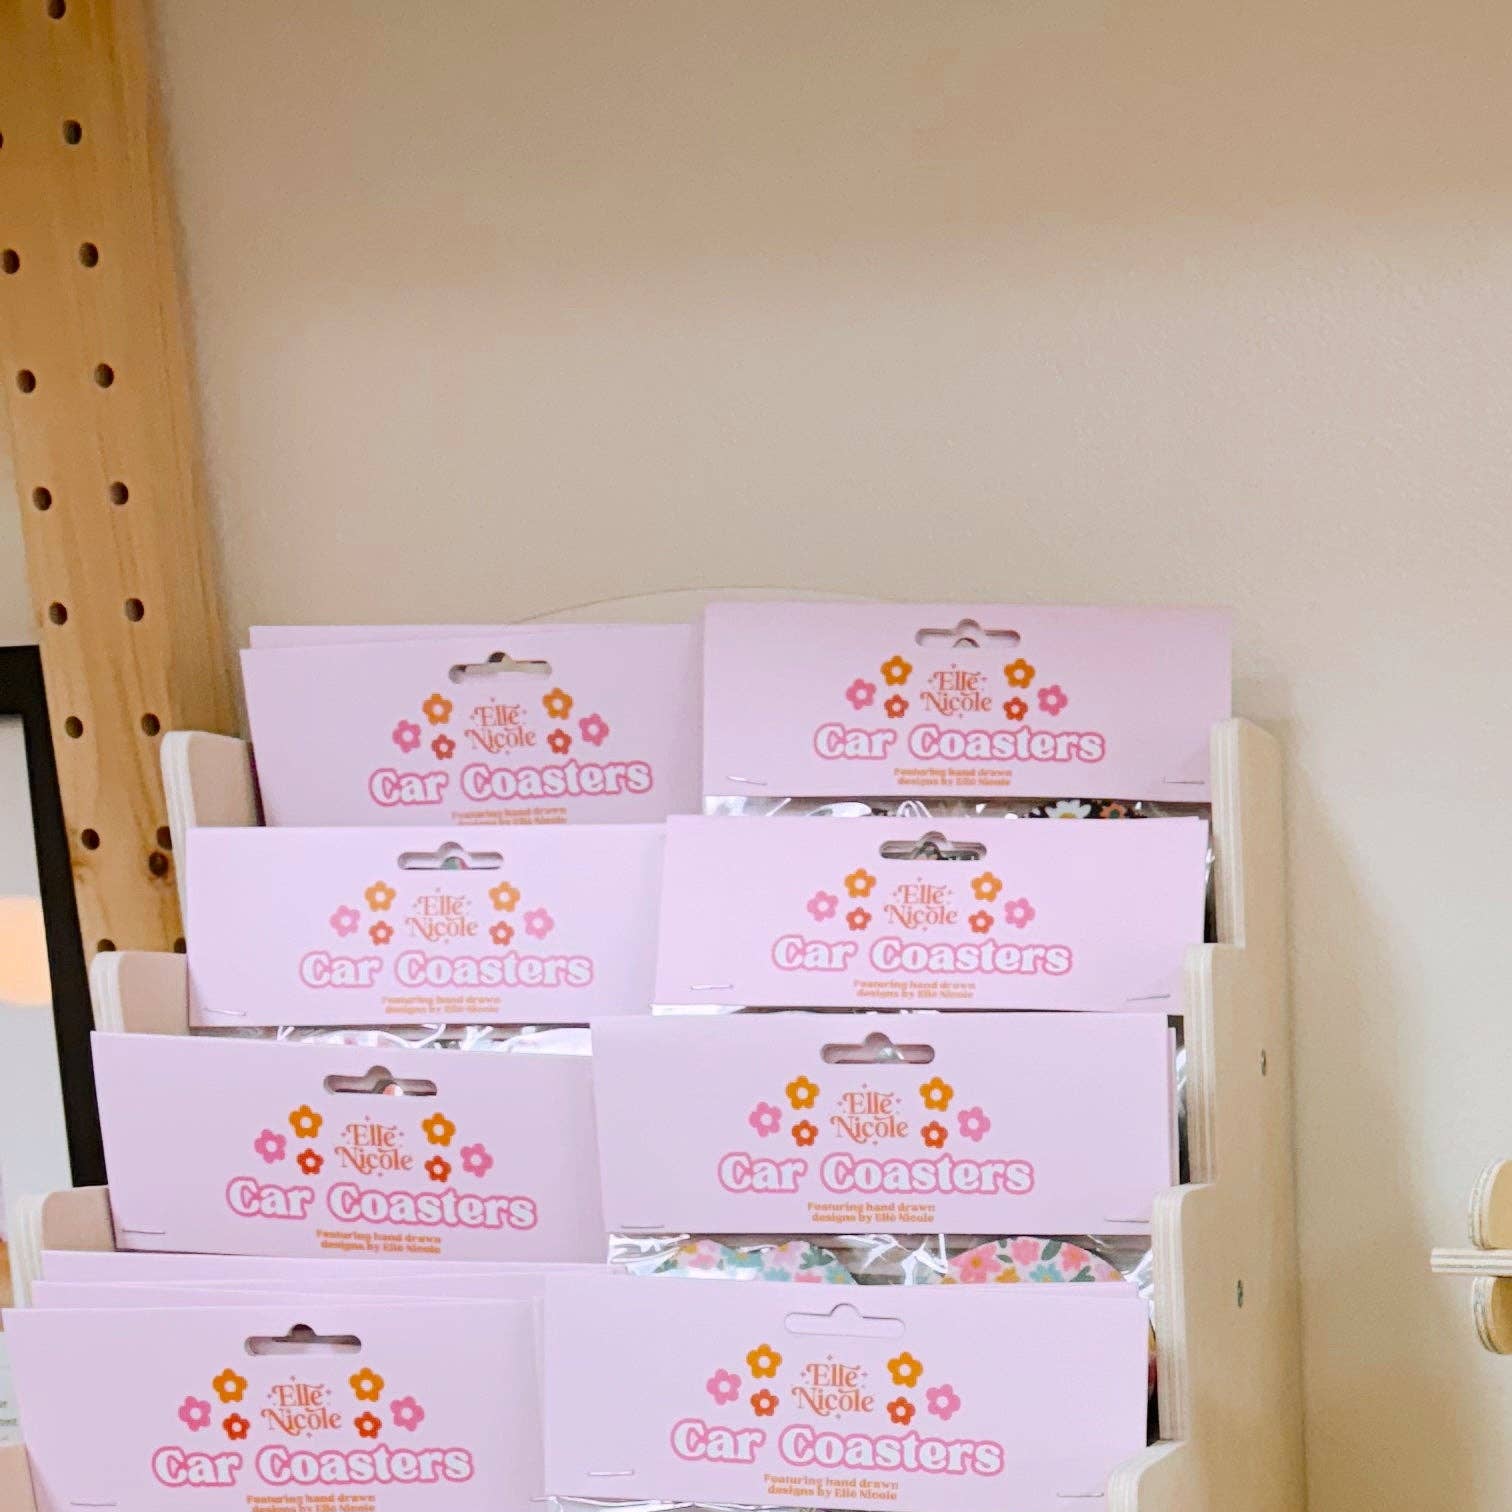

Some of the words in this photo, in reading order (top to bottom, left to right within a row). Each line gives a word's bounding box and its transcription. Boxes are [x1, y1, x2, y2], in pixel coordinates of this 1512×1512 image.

[932, 670, 980, 691] Elle
[474, 704, 521, 727] Elle
[920, 691, 992, 716] Nicole
[464, 726, 536, 753] Nicole
[814, 722, 896, 760] Car
[909, 723, 1105, 763] Coasters
[369, 769, 449, 806] Car
[461, 758, 653, 800] Coasters
[416, 895, 465, 916] Elle
[897, 884, 947, 905] Elle
[405, 916, 478, 942] Nicole
[884, 904, 958, 930] Nicole
[772, 934, 858, 972] Car
[870, 936, 1073, 975] Coasters
[300, 950, 383, 988] Car
[395, 950, 593, 988] Coasters
[842, 1092, 894, 1115] Elle
[347, 1124, 397, 1147] Elle
[830, 1114, 909, 1144] Nicole
[335, 1147, 413, 1175] Nicole
[718, 1152, 808, 1194] Car
[820, 1152, 1034, 1195] Coasters
[226, 1176, 314, 1220] Car
[327, 1182, 538, 1230] Coasters
[805, 1362, 860, 1388] Elle
[271, 1383, 324, 1407] Elle
[792, 1386, 875, 1416] Nicole
[261, 1407, 342, 1437] Nicole
[670, 1417, 767, 1463] Car
[778, 1423, 1005, 1477] Coasters
[152, 1446, 243, 1487] Car
[256, 1443, 474, 1486] Coasters
